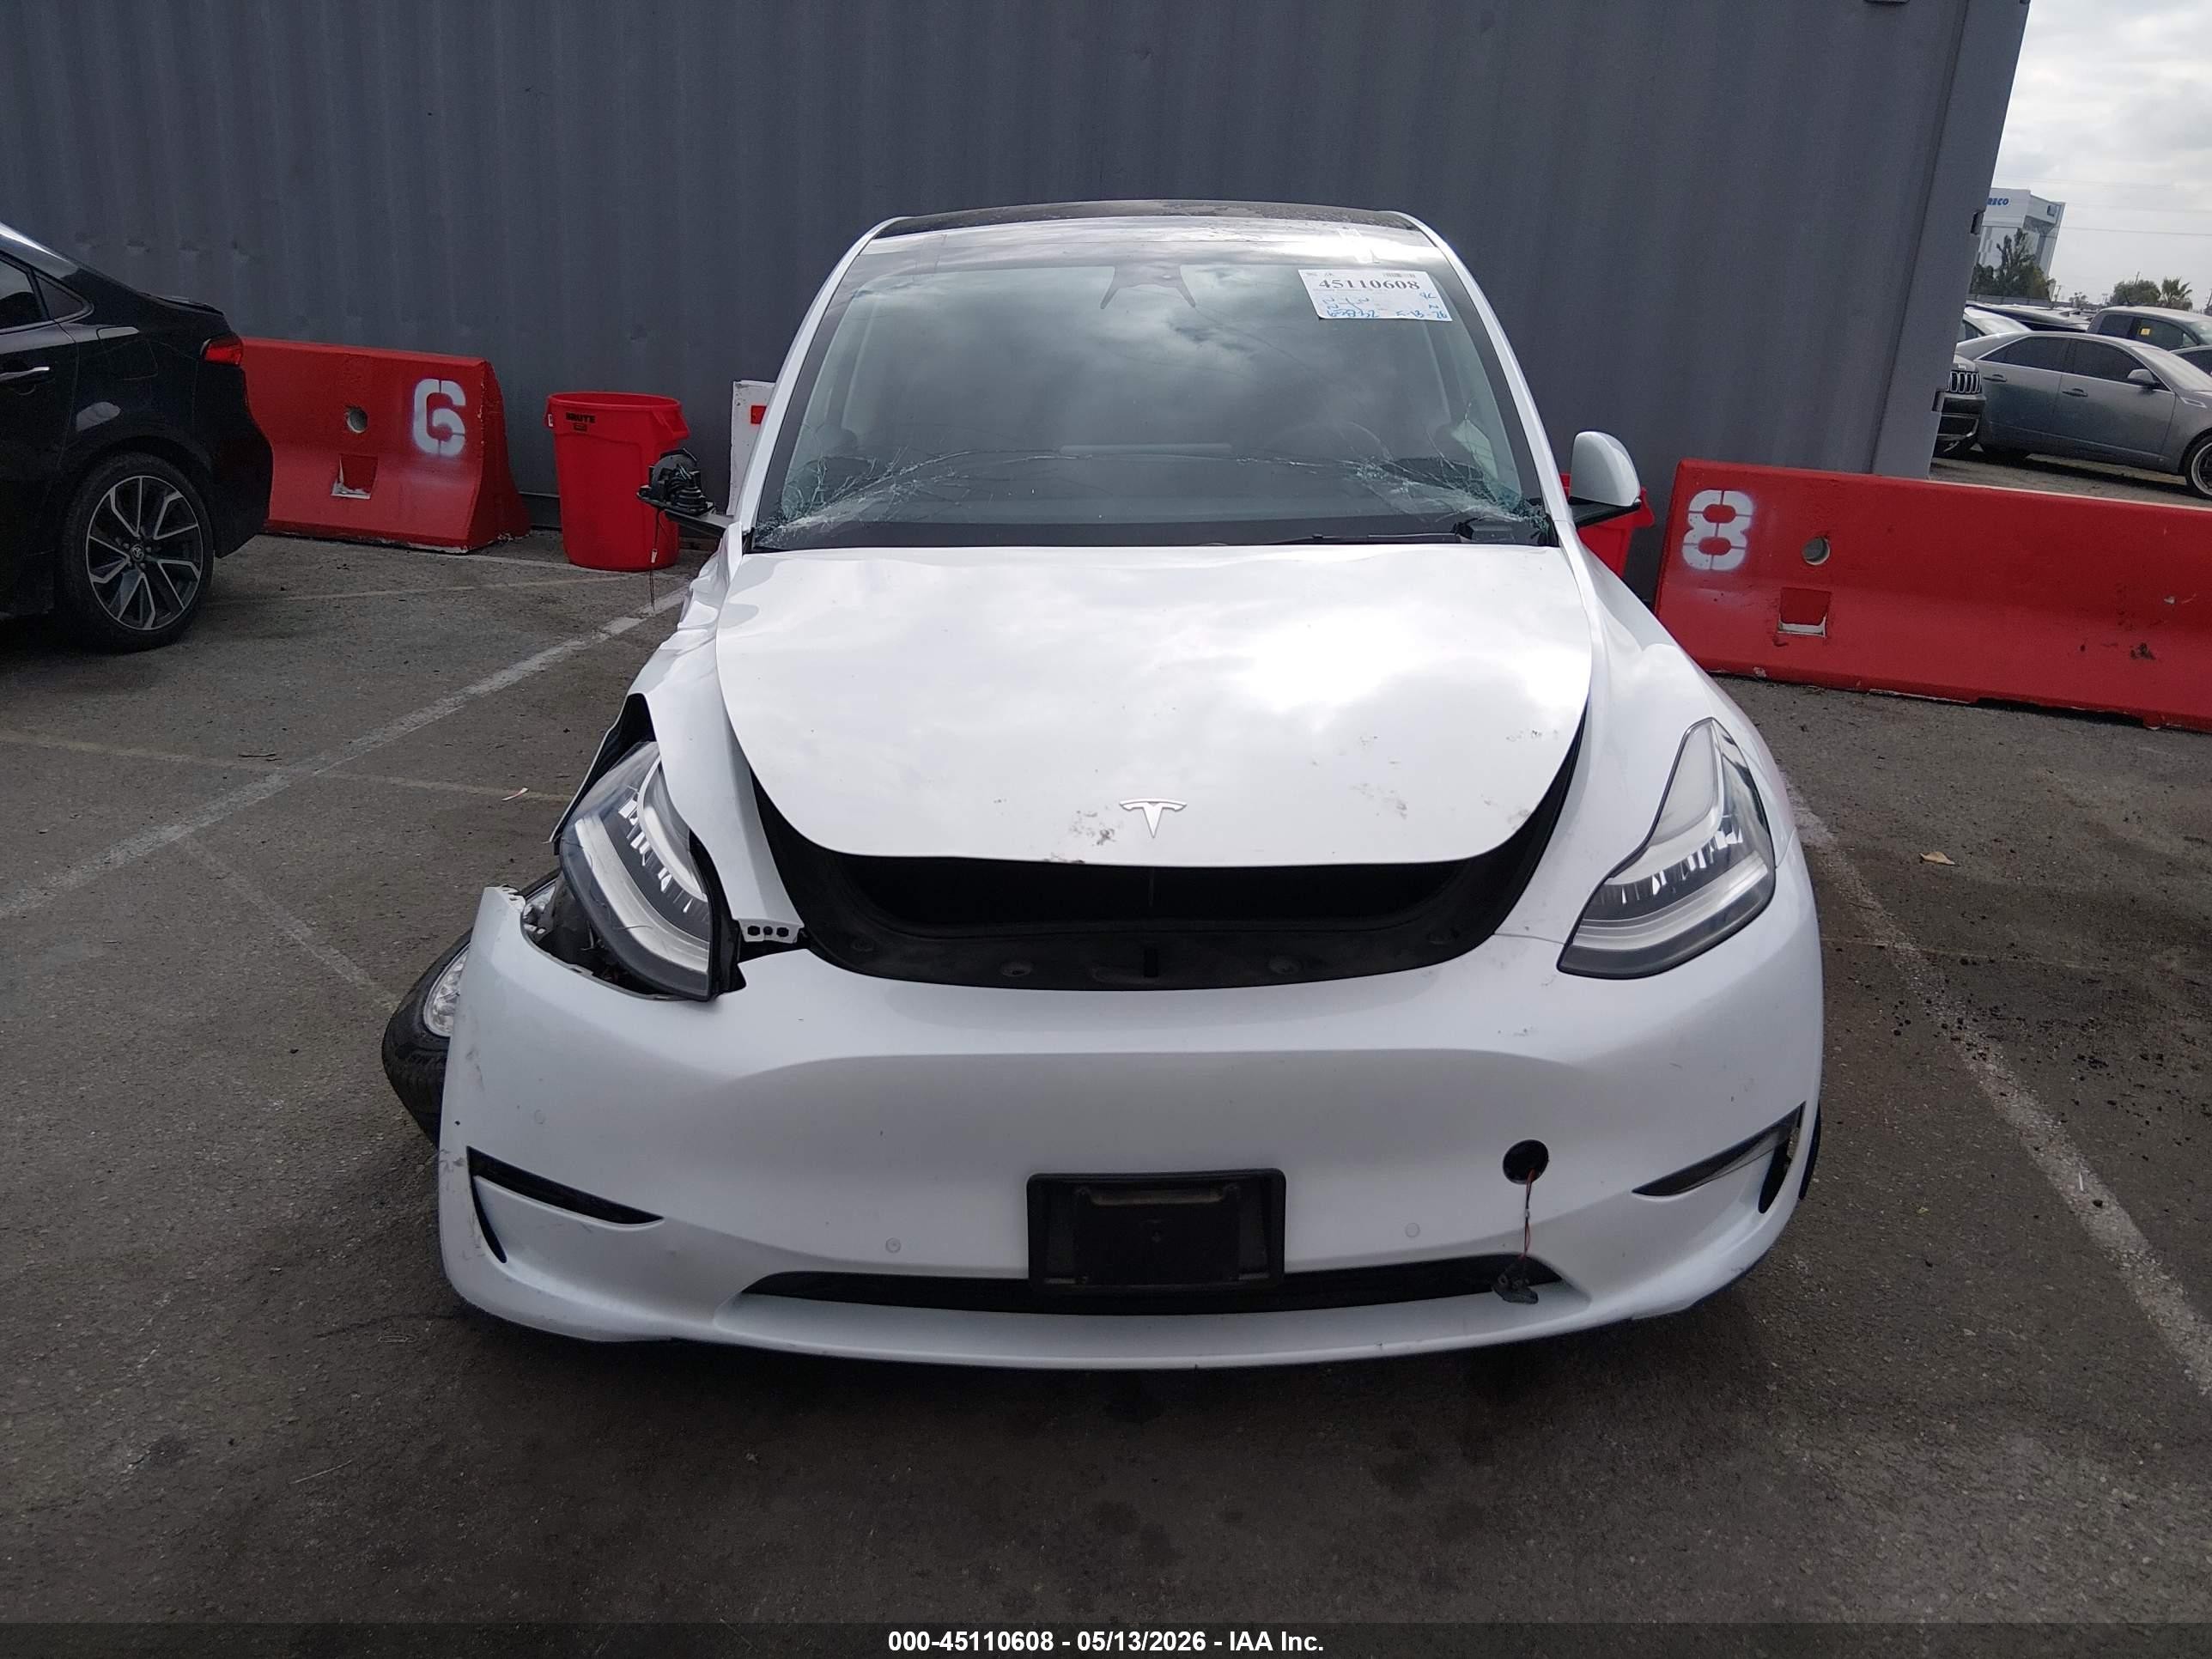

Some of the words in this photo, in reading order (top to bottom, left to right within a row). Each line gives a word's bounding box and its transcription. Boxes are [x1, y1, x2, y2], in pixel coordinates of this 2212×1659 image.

[1318, 279, 1421, 290] 45110608
[414, 378, 466, 455] 6
[1682, 489, 1753, 571] 8
